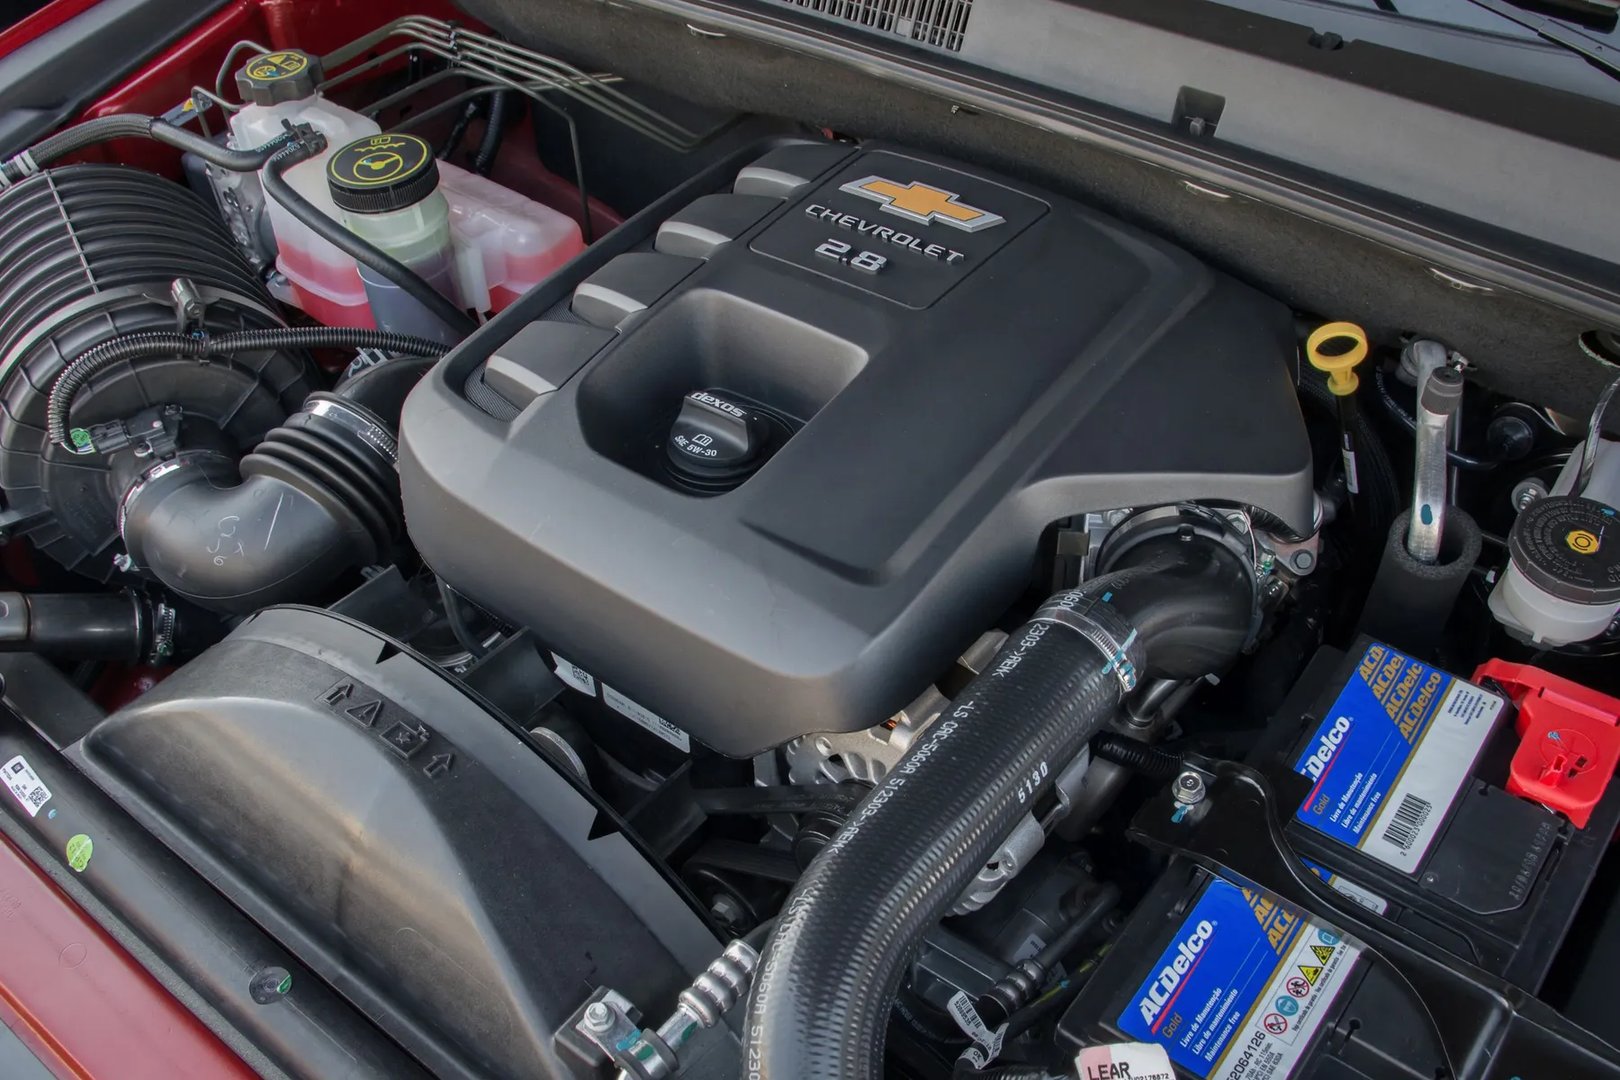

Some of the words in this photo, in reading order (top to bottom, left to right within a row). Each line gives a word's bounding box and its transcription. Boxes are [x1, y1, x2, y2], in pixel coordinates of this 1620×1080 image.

[805, 204, 965, 263] CHEVROLET
[815, 239, 887, 273] 2.8
[691, 392, 747, 417] dexos
[675, 435, 689, 447] SAE
[687, 444, 717, 457] 5W-30
[1399, 672, 1441, 740] ACDelco
[1301, 716, 1351, 783] Delco
[1018, 761, 1048, 803] 5130
[1341, 773, 1363, 803] Manutenção
[1354, 773, 1377, 809] mantenimiento
[1313, 794, 1330, 815] Gold
[1353, 802, 1375, 834] Maintenance
[1139, 920, 1213, 1025] ACDelco
[1162, 1012, 1183, 1038] Gold
[1180, 1031, 1193, 1047] Livre
[1195, 988, 1222, 1024] Manutenção
[1192, 1039, 1206, 1054] Libre
[1209, 989, 1238, 1031] mantenimiento
[1205, 1024, 1232, 1061] Maintenance
[1228, 1012, 1240, 1024] free
[1088, 1062, 1131, 1080] LEAR
